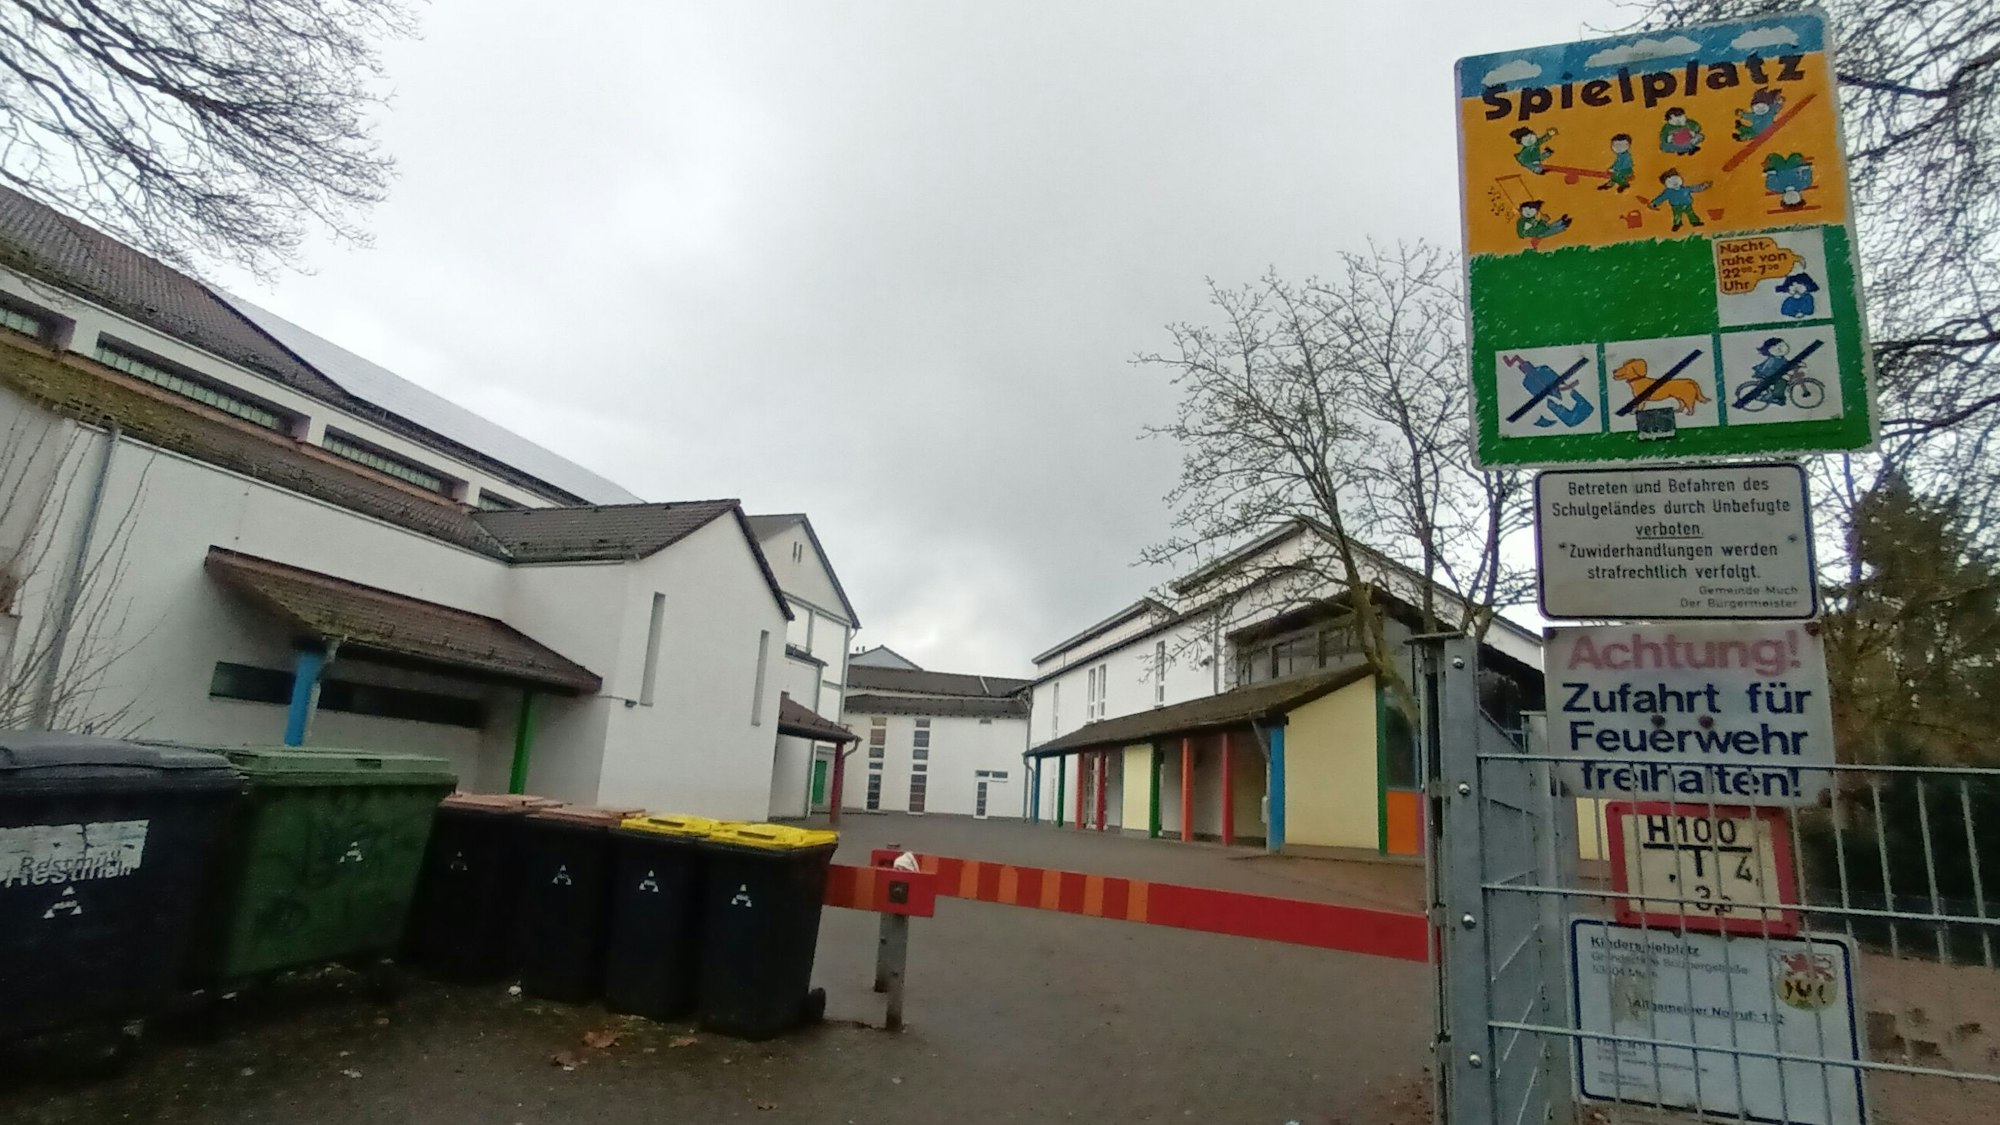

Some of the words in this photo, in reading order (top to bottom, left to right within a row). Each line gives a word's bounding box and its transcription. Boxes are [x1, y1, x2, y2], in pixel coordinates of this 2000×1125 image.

[1481, 52, 1806, 121] Spielplatz
[1720, 241, 1770, 254] Nacht-
[1721, 255, 1754, 266] ruhe
[1760, 252, 1787, 262] von
[1723, 281, 1749, 292] Uhr
[1568, 482, 1628, 495] Betreten
[1635, 480, 1661, 494] und
[1668, 478, 1735, 493] Befahren
[1743, 477, 1769, 492] des
[1552, 501, 1656, 519] Schulgeländes
[1664, 501, 1705, 515] durch
[1713, 499, 1791, 516] Unbefugte
[1636, 522, 1704, 537] verboten.
[1569, 543, 1713, 561] Zuwiderhandlungen
[1721, 543, 1778, 557] werden
[1587, 565, 1687, 580] strafrechtlich
[1695, 564, 1761, 583] verfolgt.
[1699, 585, 1760, 596] Gemeinde
[1766, 585, 1798, 595] Much
[1680, 598, 1701, 608] Der
[1567, 629, 1802, 677] Achtung!
[1562, 682, 1721, 713] Zufahrt
[1745, 682, 1812, 714] für
[1569, 721, 1809, 755] Feuerwehr
[1581, 761, 1801, 797] freihaten!
[1646, 815, 1736, 844] H100
[1762, 1012, 1785, 1025] 12
